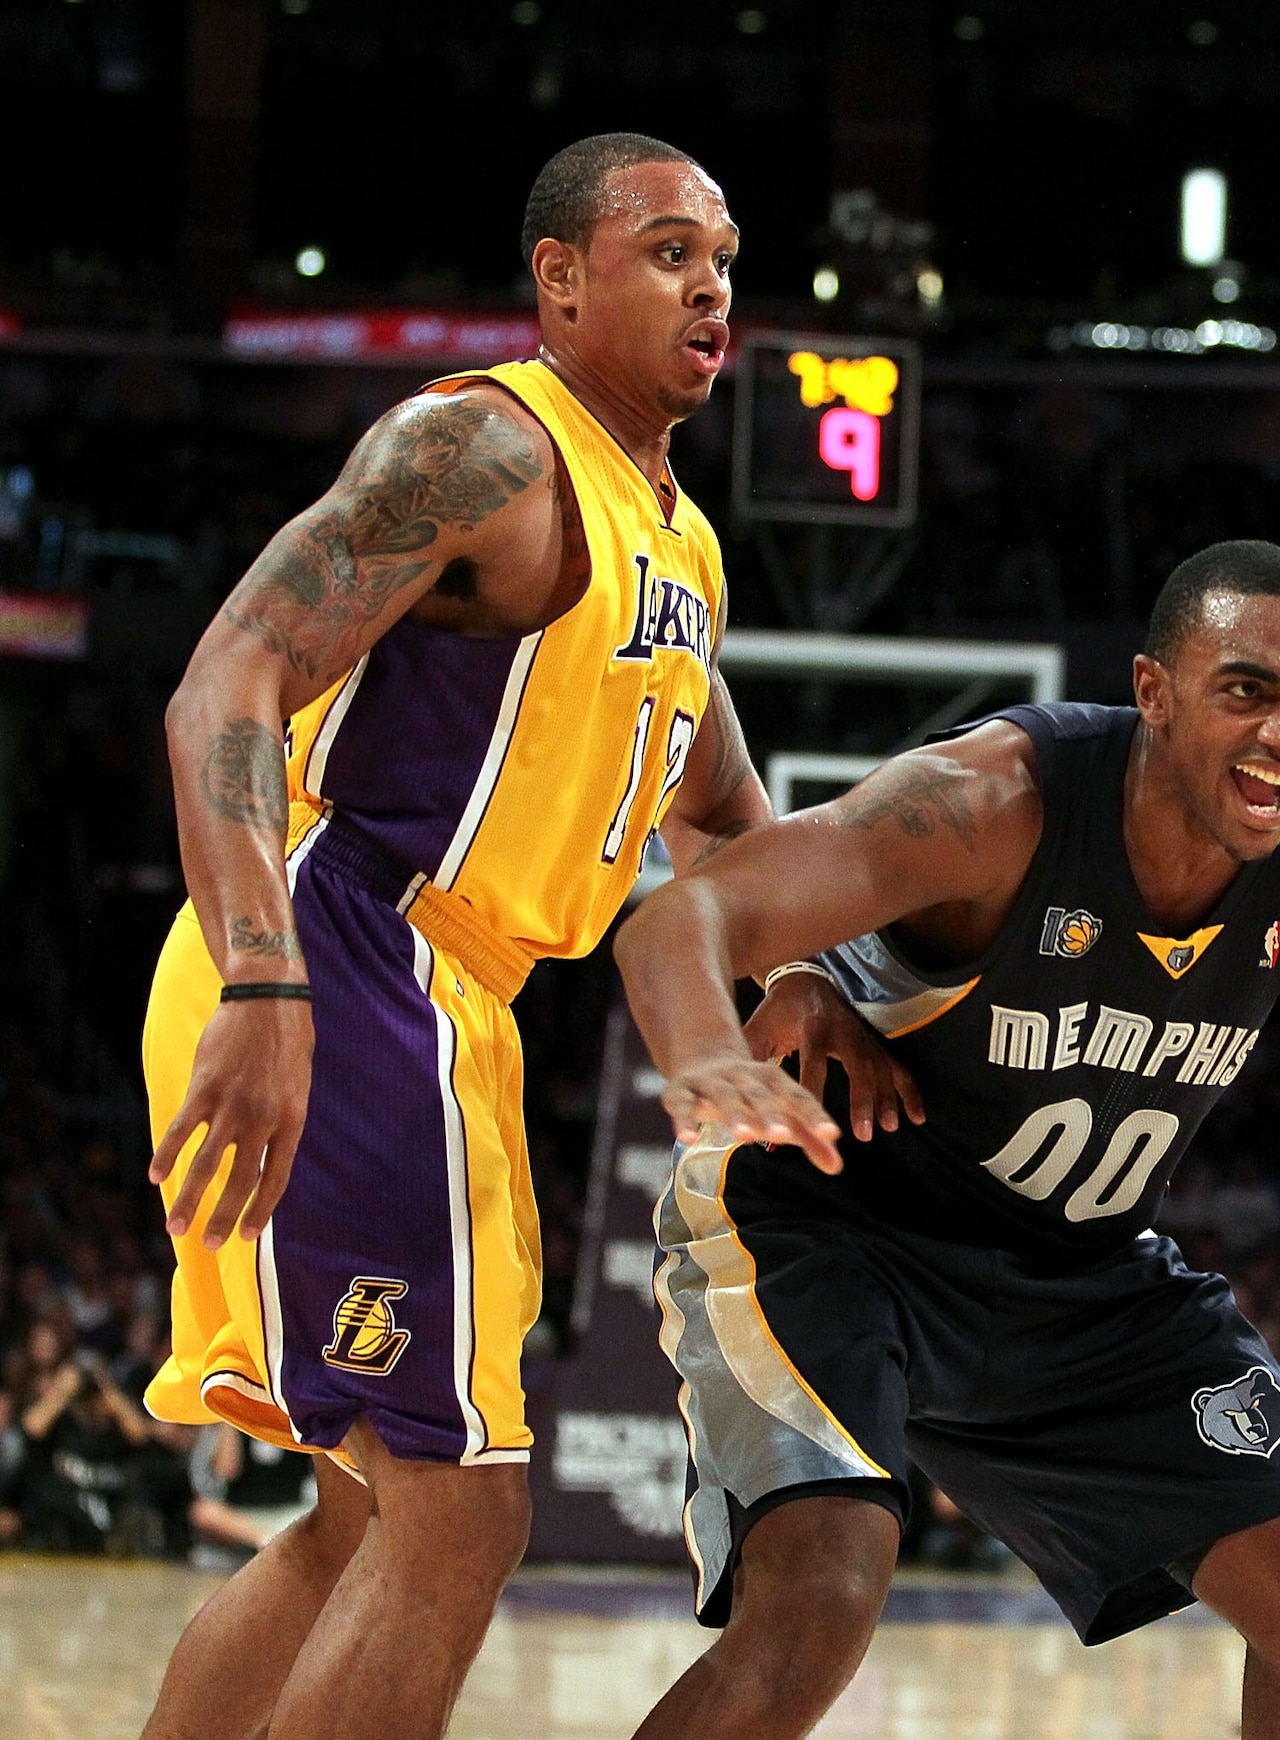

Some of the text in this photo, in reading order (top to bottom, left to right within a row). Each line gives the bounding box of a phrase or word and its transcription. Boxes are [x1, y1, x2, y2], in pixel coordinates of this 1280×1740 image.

[818, 406, 881, 502] 9
[987, 1001, 1262, 1088] MEMPHIS
[979, 1098, 1179, 1222] 00
